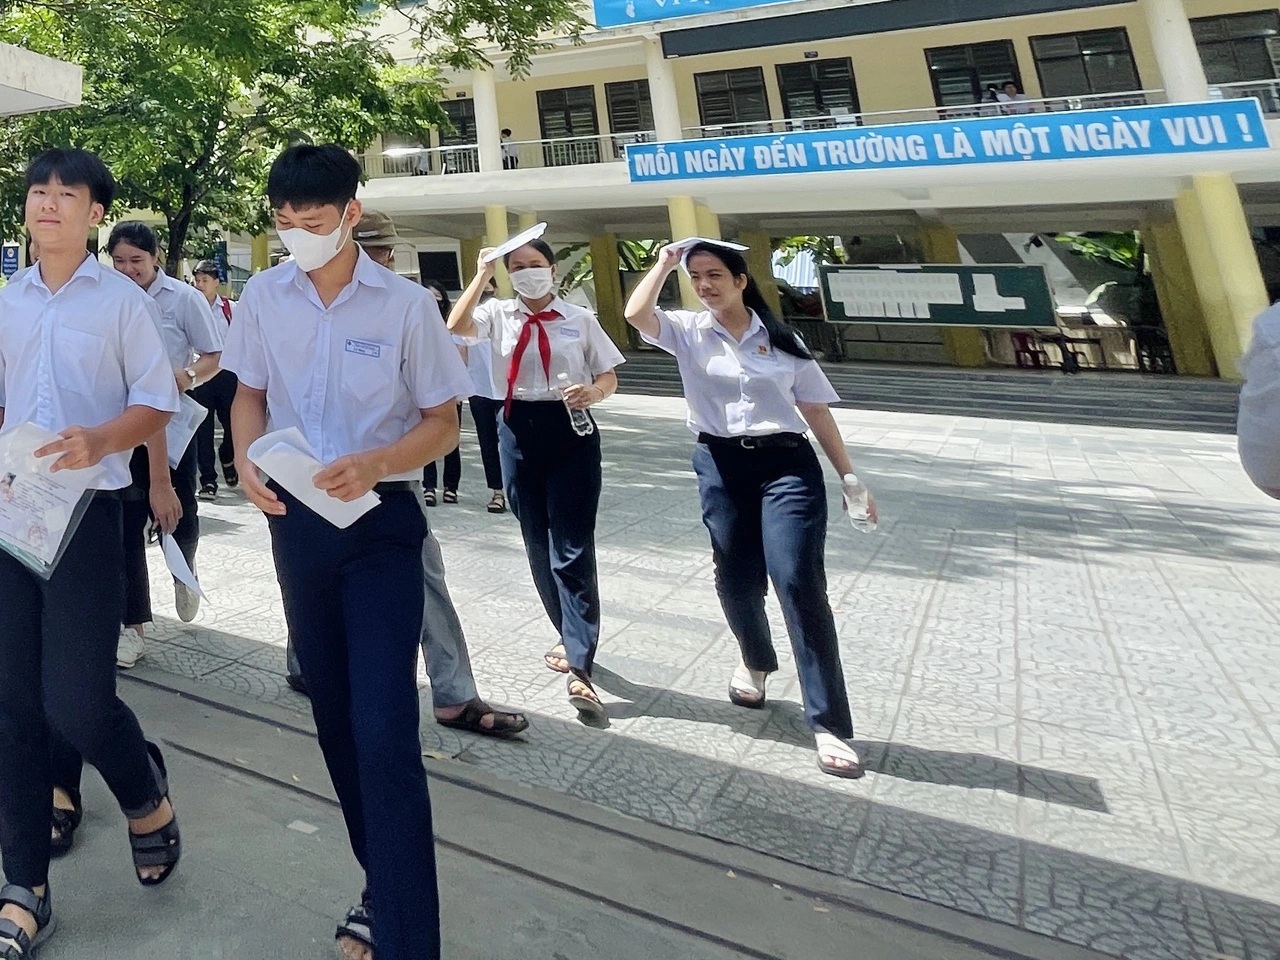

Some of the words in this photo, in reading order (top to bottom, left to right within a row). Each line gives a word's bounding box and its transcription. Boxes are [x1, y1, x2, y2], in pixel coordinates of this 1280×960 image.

[635, 144, 678, 177] MỖI
[685, 144, 746, 173] NGÀY
[753, 136, 807, 170] ĐẾN
[812, 132, 928, 166] TRƯỜNG
[933, 126, 975, 159] LÀ
[980, 122, 1051, 161] MỘT
[1060, 116, 1151, 152] NGÀY
[1161, 115, 1229, 147] VUI
[1235, 113, 1254, 142] !
